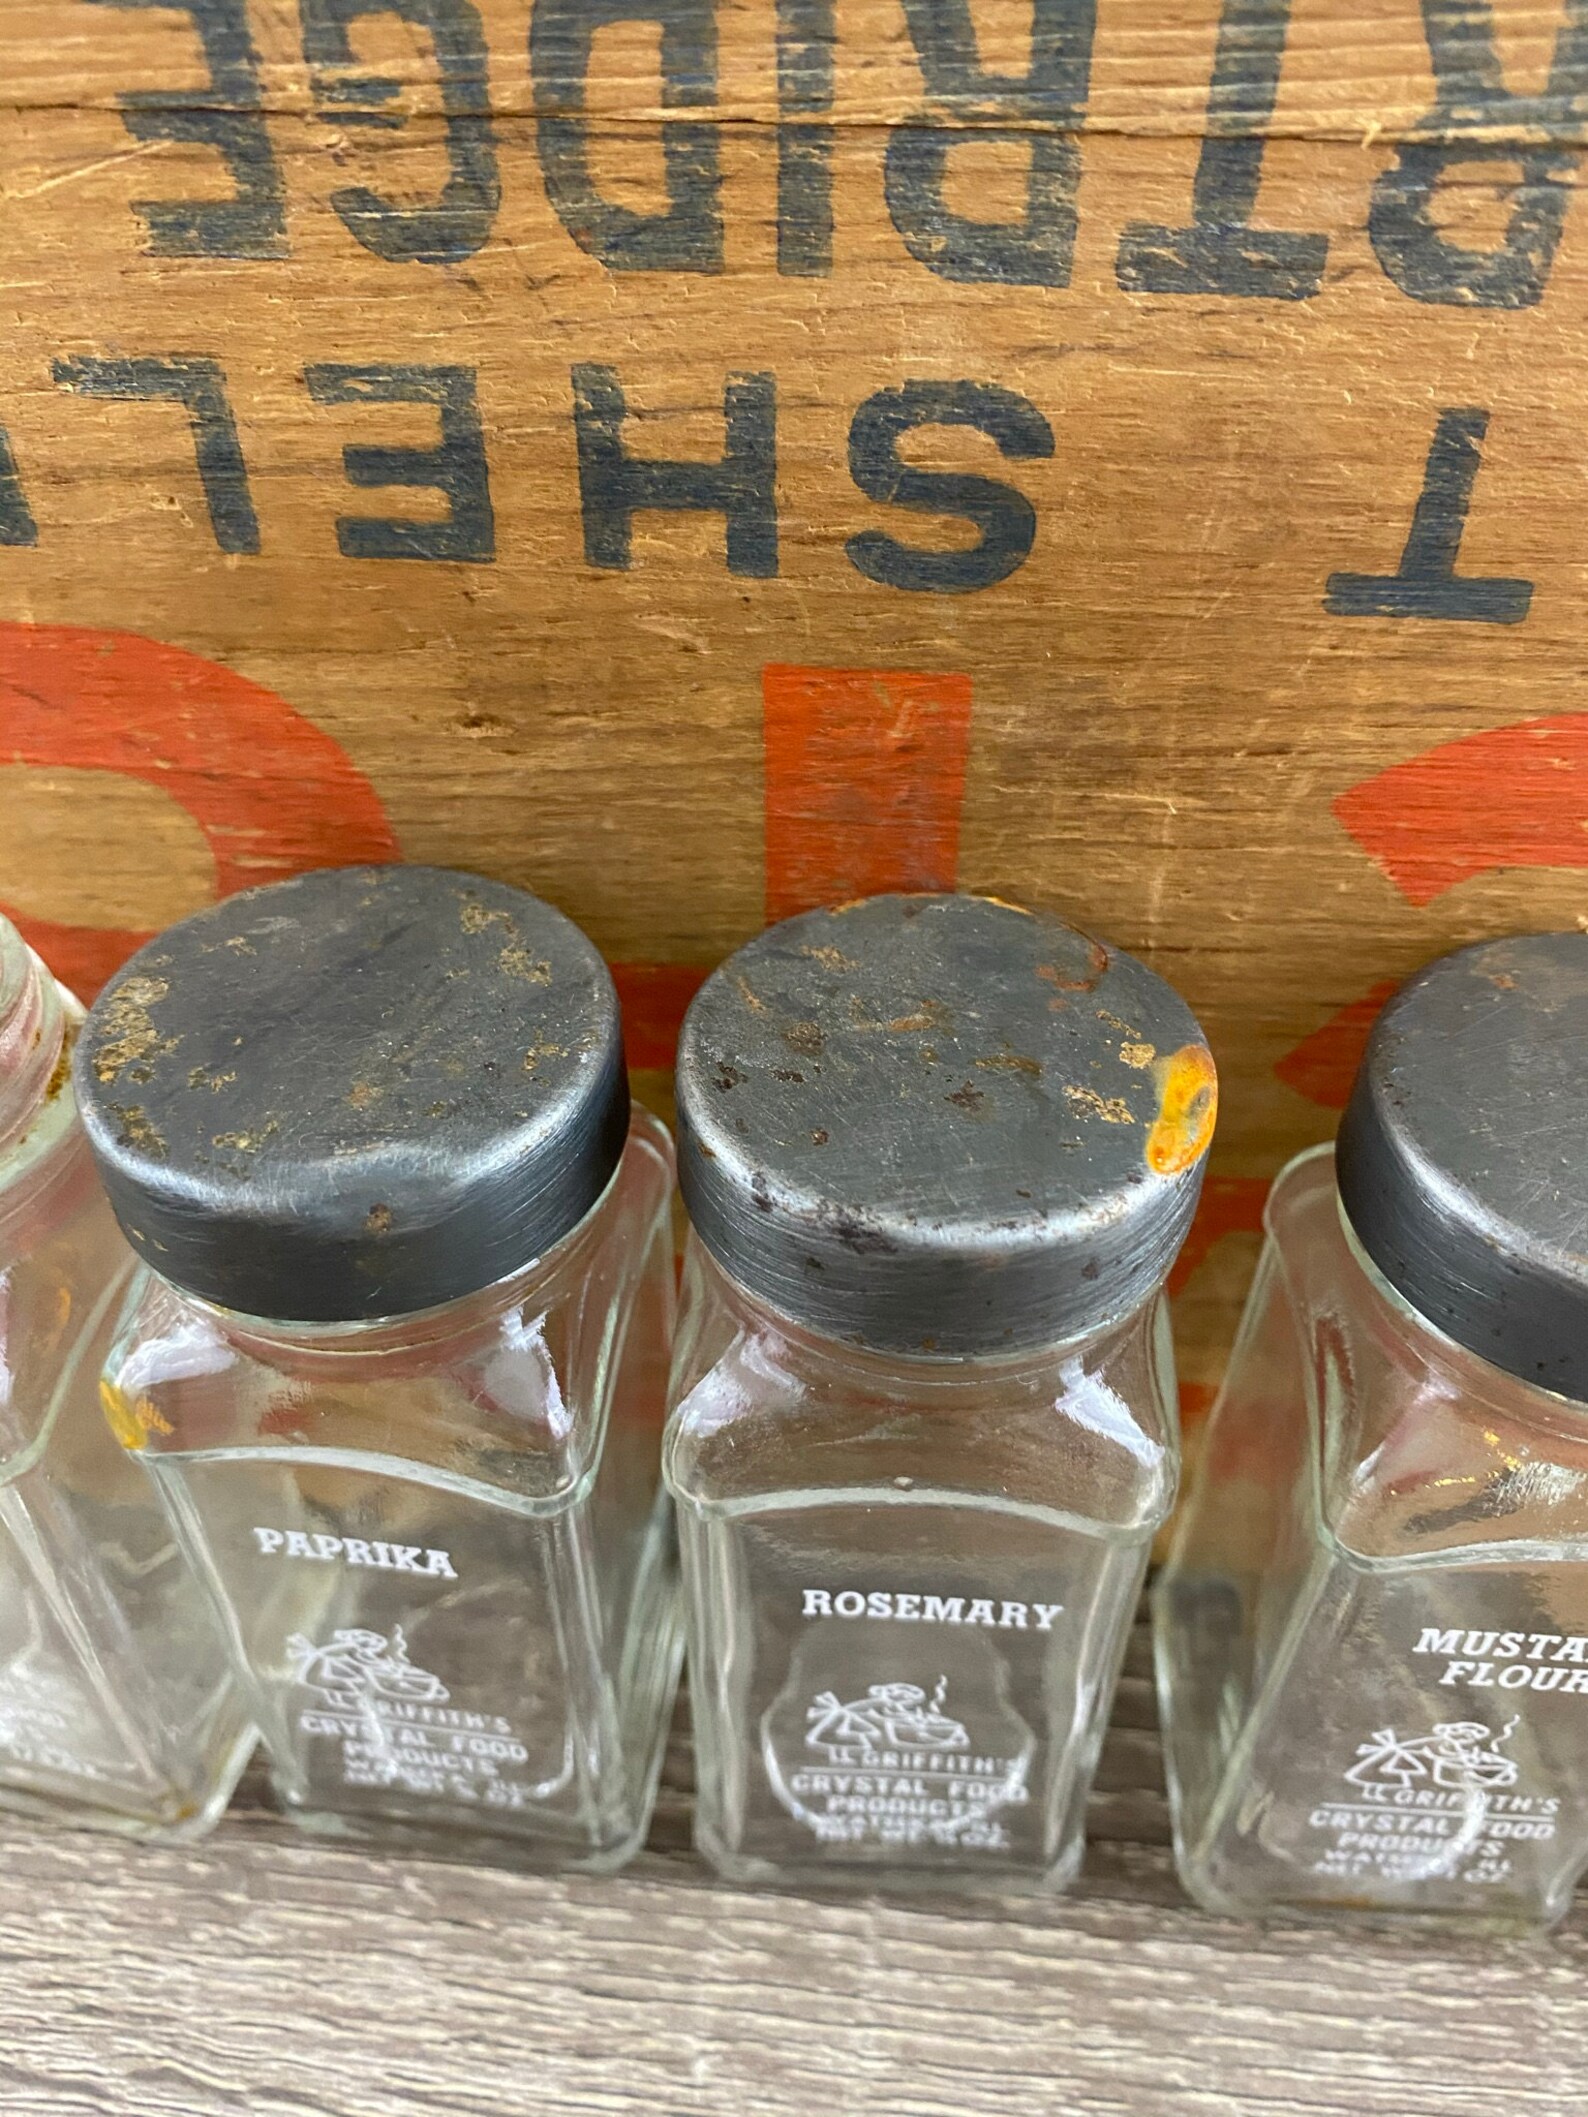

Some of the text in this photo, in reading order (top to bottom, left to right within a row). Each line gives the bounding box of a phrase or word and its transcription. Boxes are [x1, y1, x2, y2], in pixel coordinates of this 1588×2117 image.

[1322, 407, 1535, 624] T
[253, 1526, 459, 1579] PAPRIKA
[802, 1589, 1065, 1630] ROSEMARY
[1412, 1627, 1588, 1664] MUSTA
[1438, 1660, 1588, 1694] FLOUR
[360, 1698, 512, 1734] RIFFITH'S
[344, 1739, 500, 1776] PDUCTS
[453, 1735, 529, 1764] FOOD
[791, 1774, 930, 1796] CRYSTAL
[1394, 1788, 1561, 1814] GRIFTH'S
[826, 1796, 986, 1819] PRODUCTS
[1308, 1809, 1556, 1840] CRYSTAL OOD
[1337, 1831, 1506, 1857] PRODUTS
